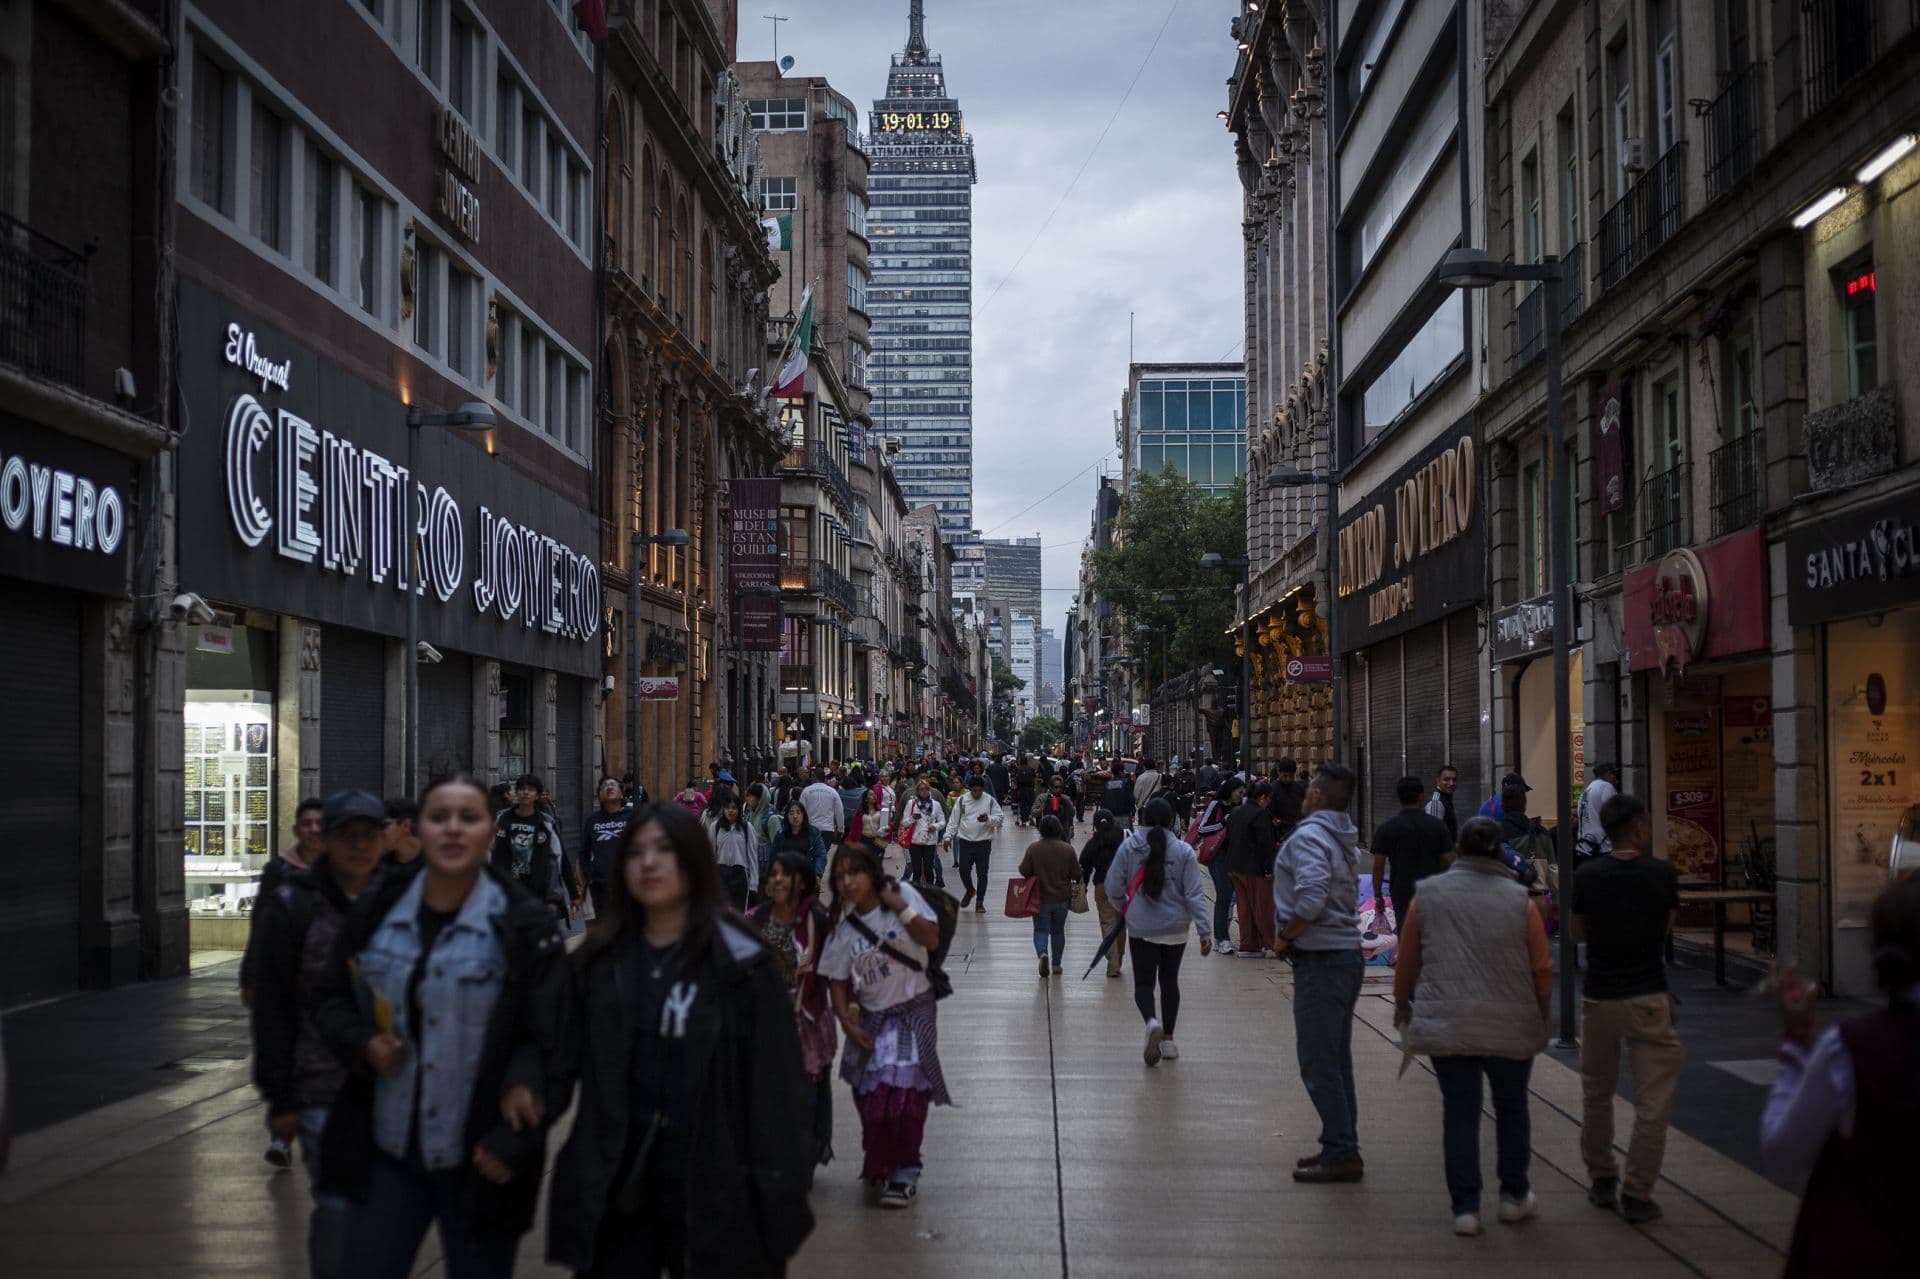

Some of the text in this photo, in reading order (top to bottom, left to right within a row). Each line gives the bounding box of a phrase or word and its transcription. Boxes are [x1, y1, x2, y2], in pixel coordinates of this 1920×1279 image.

[440, 109, 480, 185] CENTRO
[441, 168, 480, 245] JOYERO
[225, 322, 244, 366] El
[0, 455, 124, 553] OYERO
[225, 393, 599, 642] CENTRO JOYERO
[744, 521, 768, 531] DEL
[1338, 435, 1475, 598] ENTRO JOYERO
[733, 532, 776, 543] ESTAN
[1807, 538, 1872, 588] SANTA
[1860, 770, 1896, 785] 2x1
[659, 981, 698, 1038] NY
